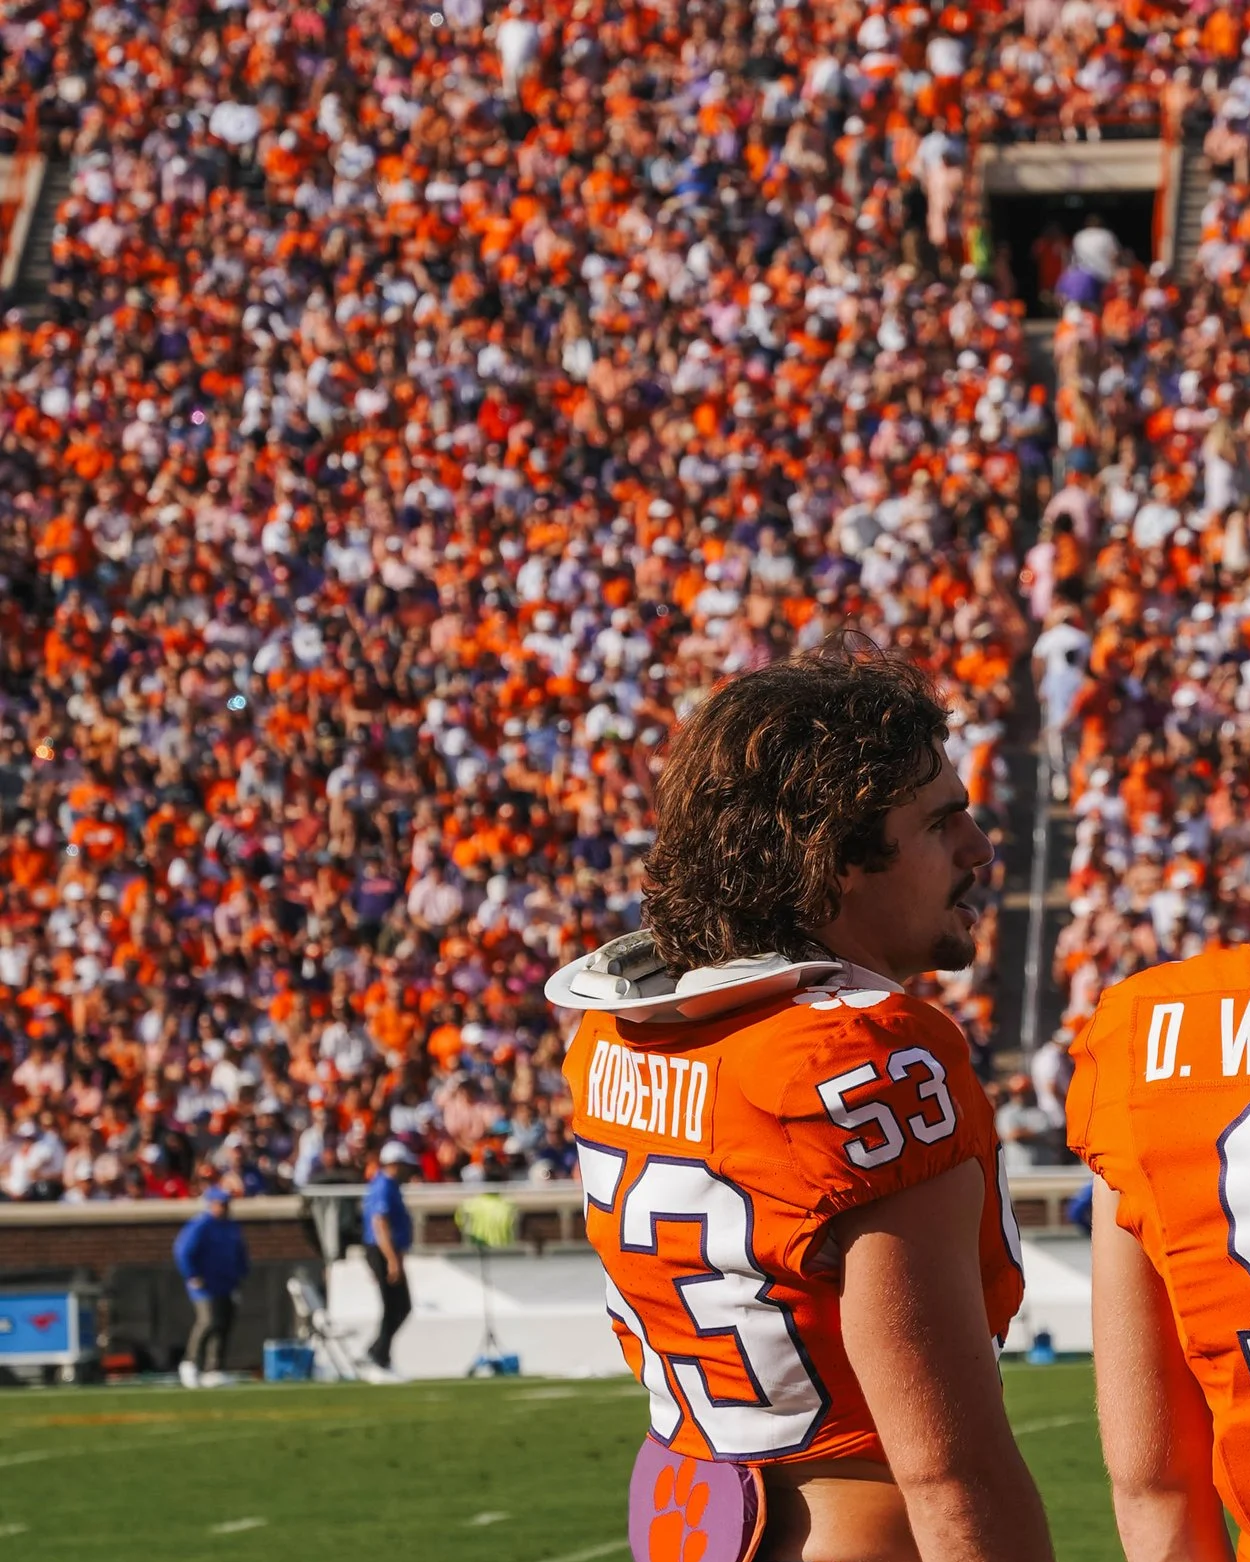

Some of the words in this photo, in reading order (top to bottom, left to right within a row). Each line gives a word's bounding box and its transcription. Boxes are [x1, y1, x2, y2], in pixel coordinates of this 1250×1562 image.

[586, 1039, 709, 1143] ROBERTO
[1145, 1002, 1191, 1083] D.
[816, 1045, 957, 1171] 53
